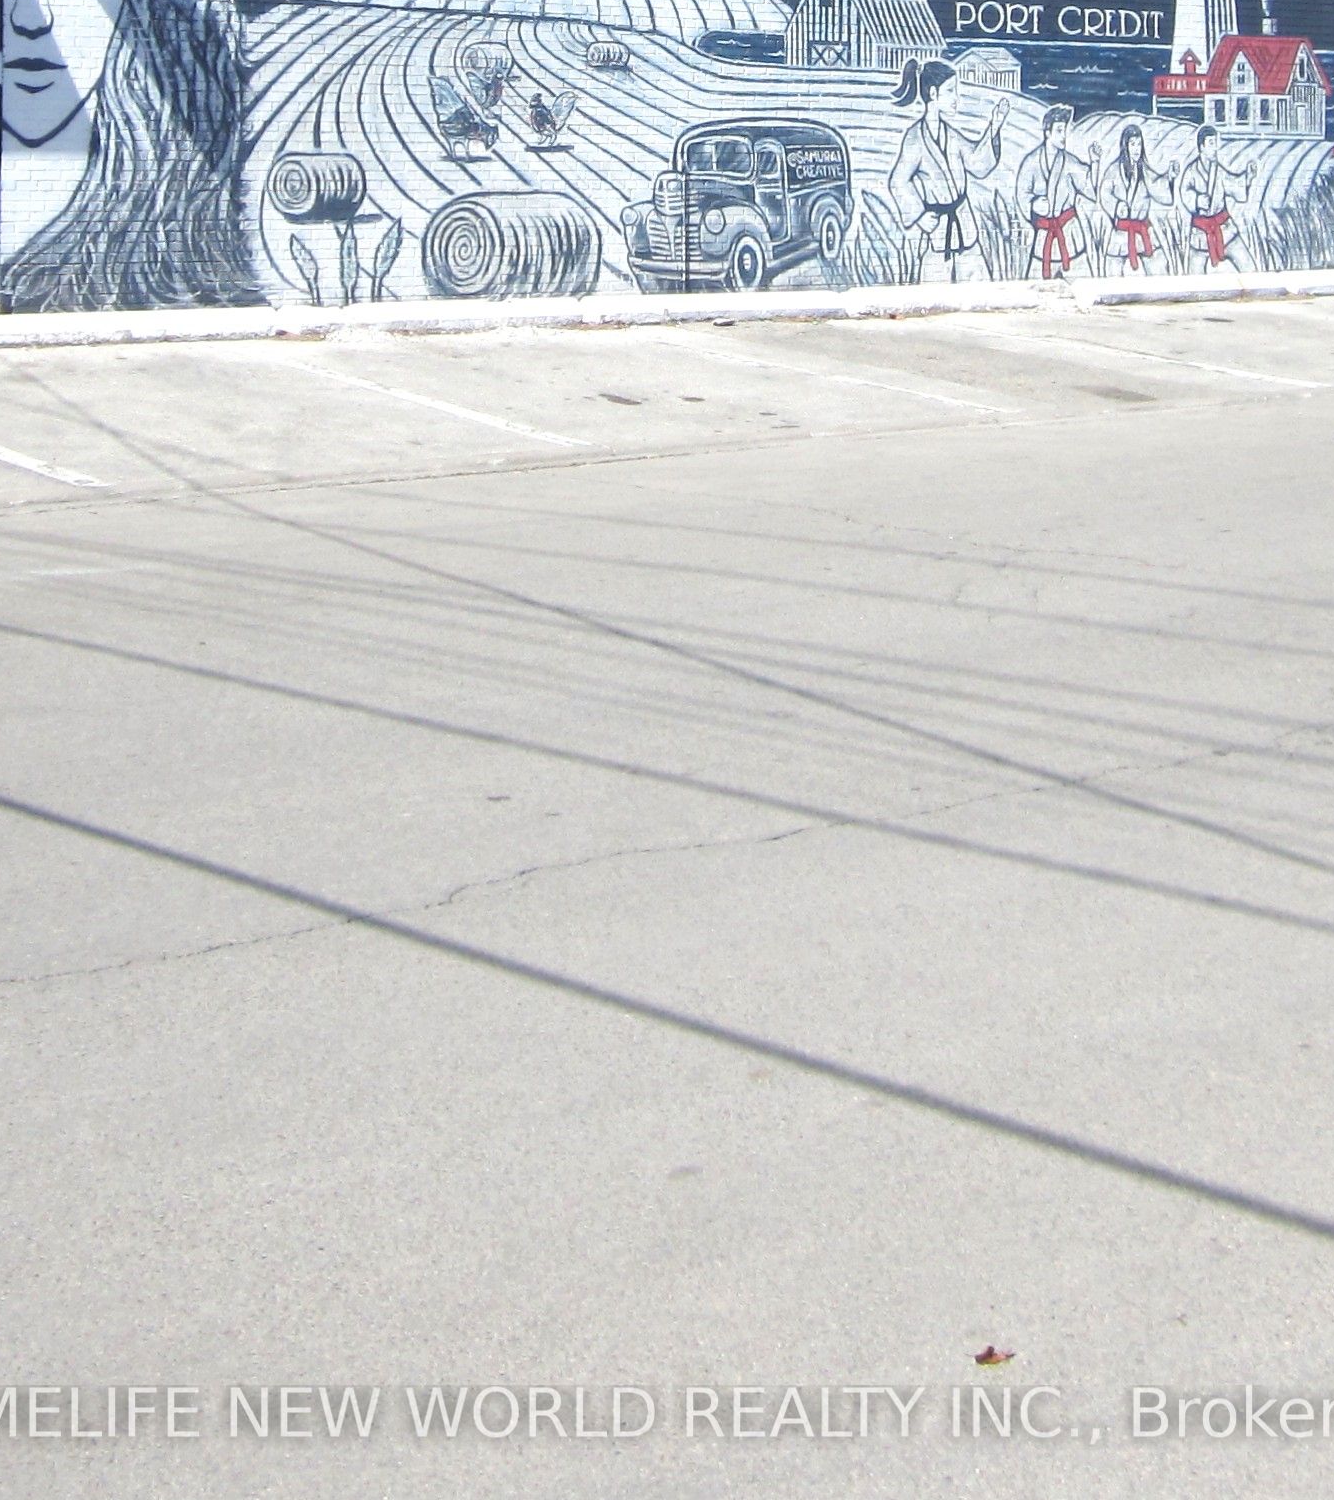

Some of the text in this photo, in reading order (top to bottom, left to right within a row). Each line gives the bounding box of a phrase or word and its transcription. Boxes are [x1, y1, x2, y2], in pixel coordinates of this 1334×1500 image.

[955, 1, 1164, 39] PORT CREDIT
[787, 150, 842, 167] @SAMURAI
[796, 164, 844, 179] CREATIVE
